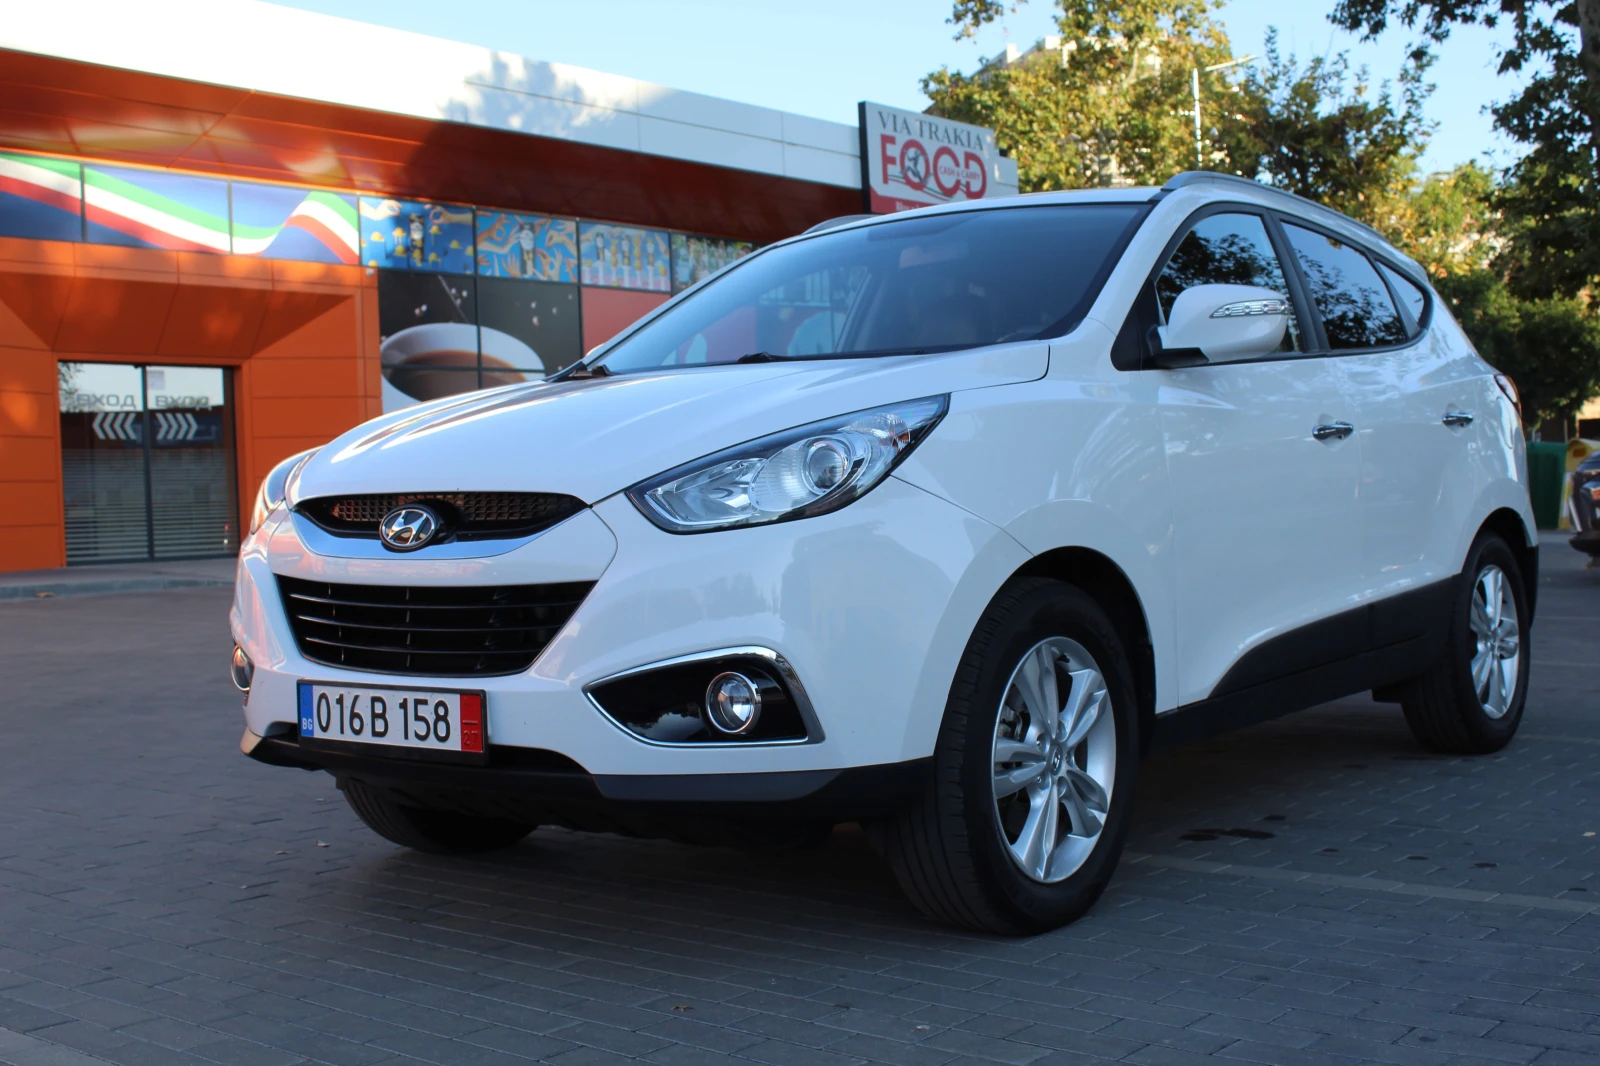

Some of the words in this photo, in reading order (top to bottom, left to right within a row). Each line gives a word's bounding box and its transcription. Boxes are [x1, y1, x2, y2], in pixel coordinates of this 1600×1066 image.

[878, 112, 911, 135] VIA
[916, 119, 983, 150] TRAKIA
[76, 394, 136, 409] ВХОД
[302, 718, 313, 730] BG
